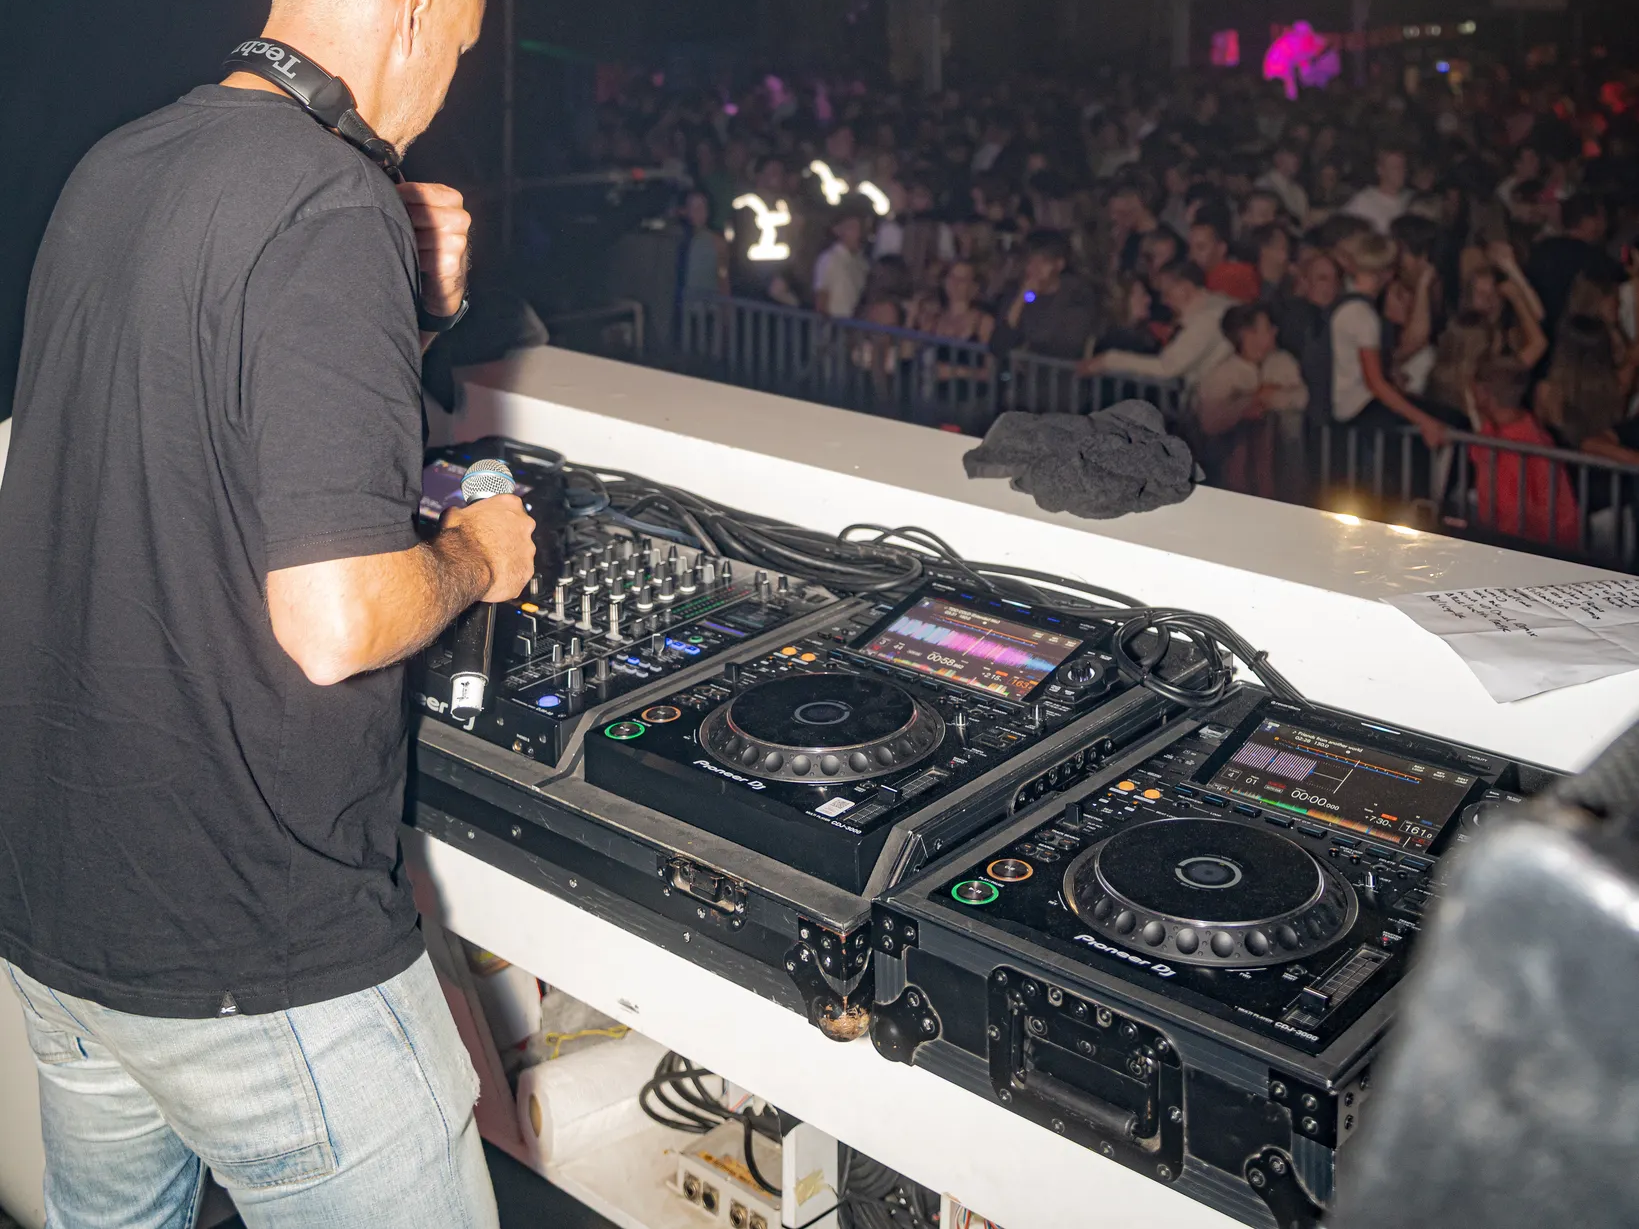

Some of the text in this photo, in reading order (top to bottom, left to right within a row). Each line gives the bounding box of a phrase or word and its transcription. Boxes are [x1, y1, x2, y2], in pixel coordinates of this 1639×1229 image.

[1297, 731, 1316, 739] Friends
[1327, 740, 1347, 748] another
[693, 759, 749, 782] Pioneer
[1244, 777, 1257, 785] 01
[1404, 824, 1433, 838] 161.0
[1073, 934, 1151, 966] Pioneer
[1274, 1021, 1319, 1042] CDJ-3000
